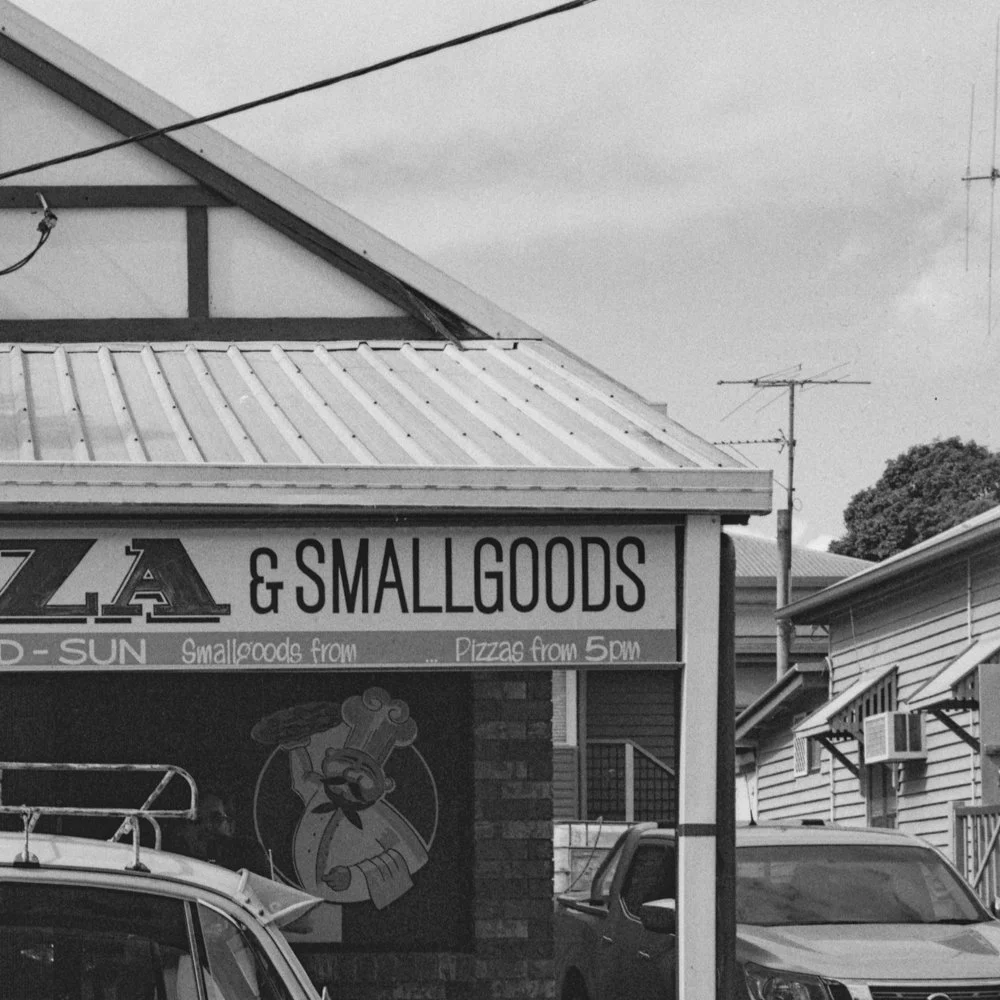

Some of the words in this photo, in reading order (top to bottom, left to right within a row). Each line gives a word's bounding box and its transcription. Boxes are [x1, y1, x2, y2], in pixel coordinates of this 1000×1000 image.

[250, 547, 284, 614] &
[295, 536, 646, 614] SMALLGOODS
[182, 637, 302, 665] Smallgoods
[310, 637, 357, 664] from
[455, 636, 524, 663] Pizzas
[530, 635, 578, 662] from
[584, 635, 641, 663] 5pm
